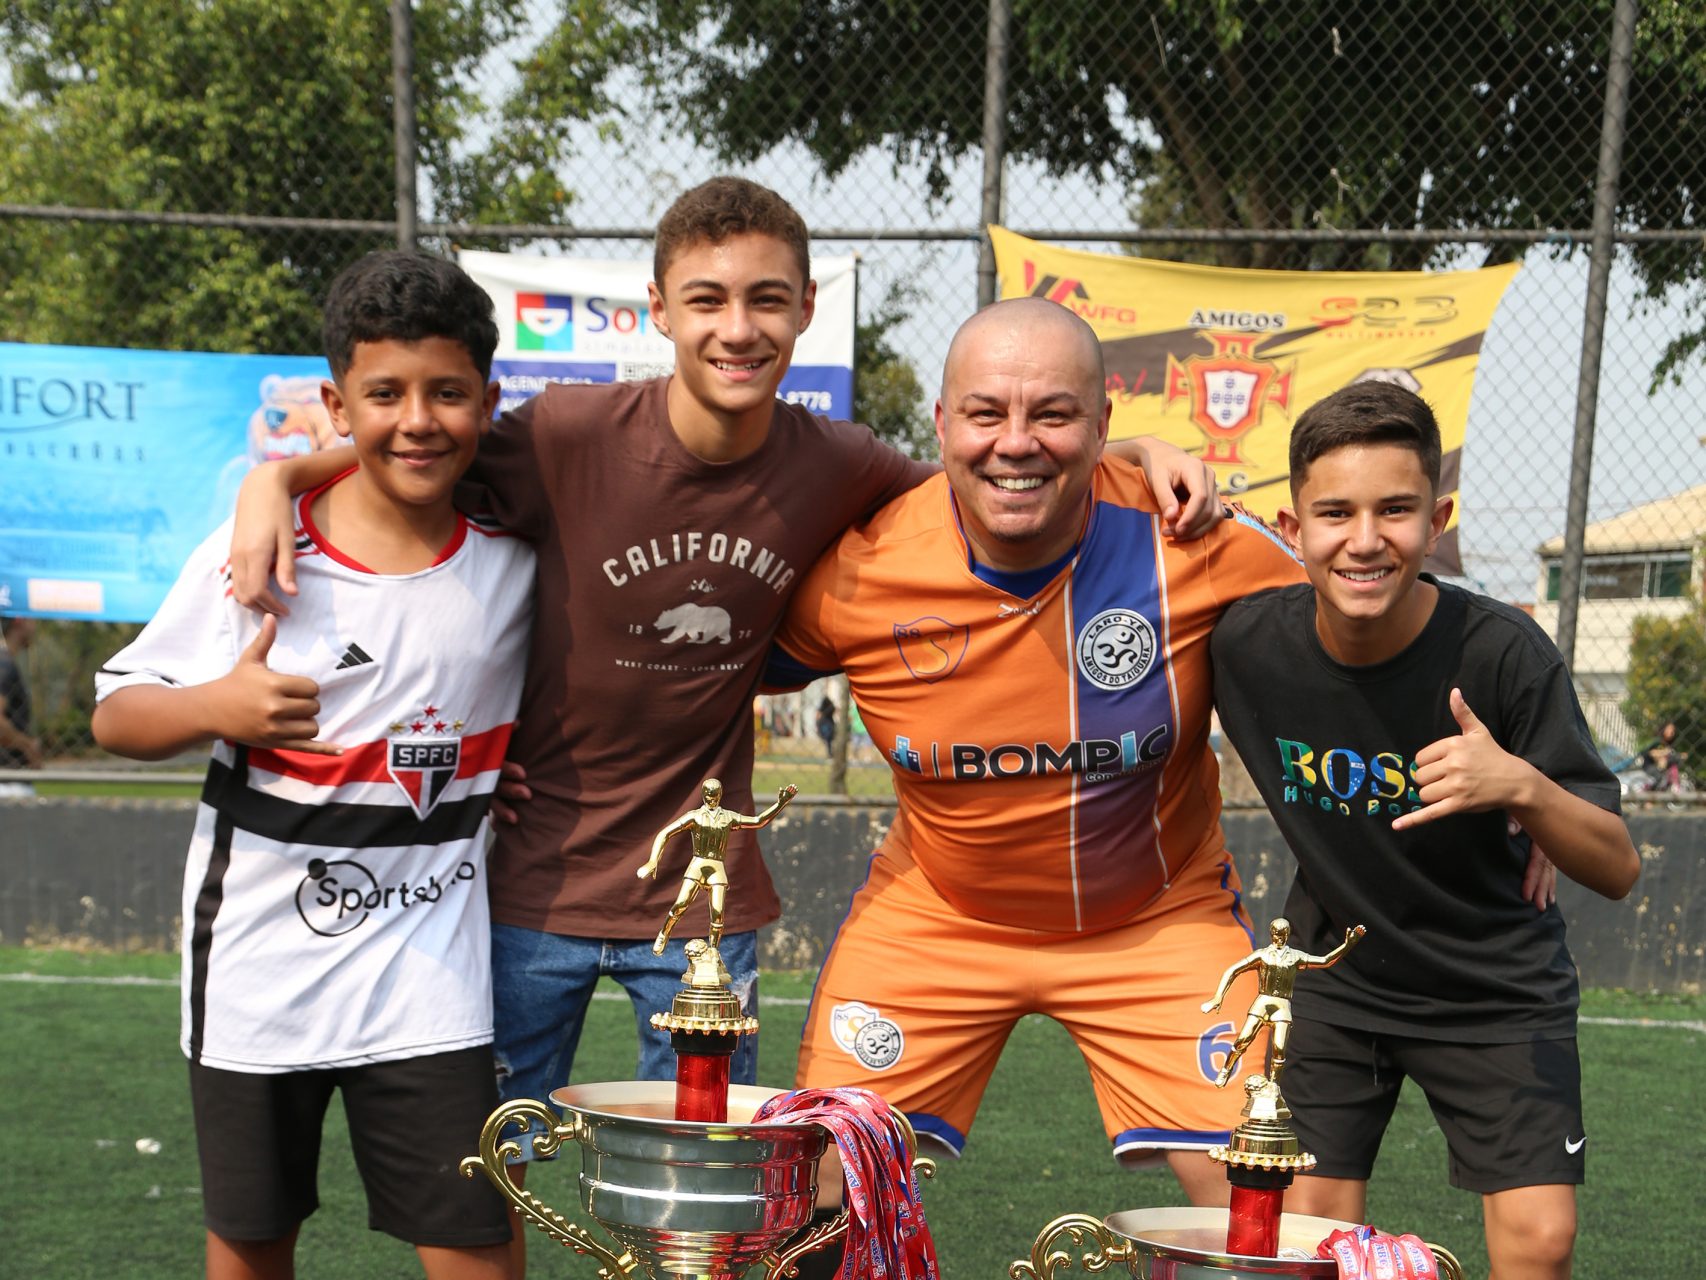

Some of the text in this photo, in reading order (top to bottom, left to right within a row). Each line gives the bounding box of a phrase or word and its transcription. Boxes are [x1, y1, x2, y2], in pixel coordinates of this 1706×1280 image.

[1190, 310, 1284, 328] AMIGOS
[602, 532, 795, 594] CALIFORNIA
[628, 623, 643, 635] 19
[615, 659, 642, 669] WEST
[647, 663, 679, 672] COAST
[1084, 655, 1108, 682] AMIGOS
[1109, 676, 1120, 684] DO
[398, 746, 454, 765] SPFC
[1284, 785, 1350, 817] HUGO
[1199, 1022, 1241, 1083] 6
